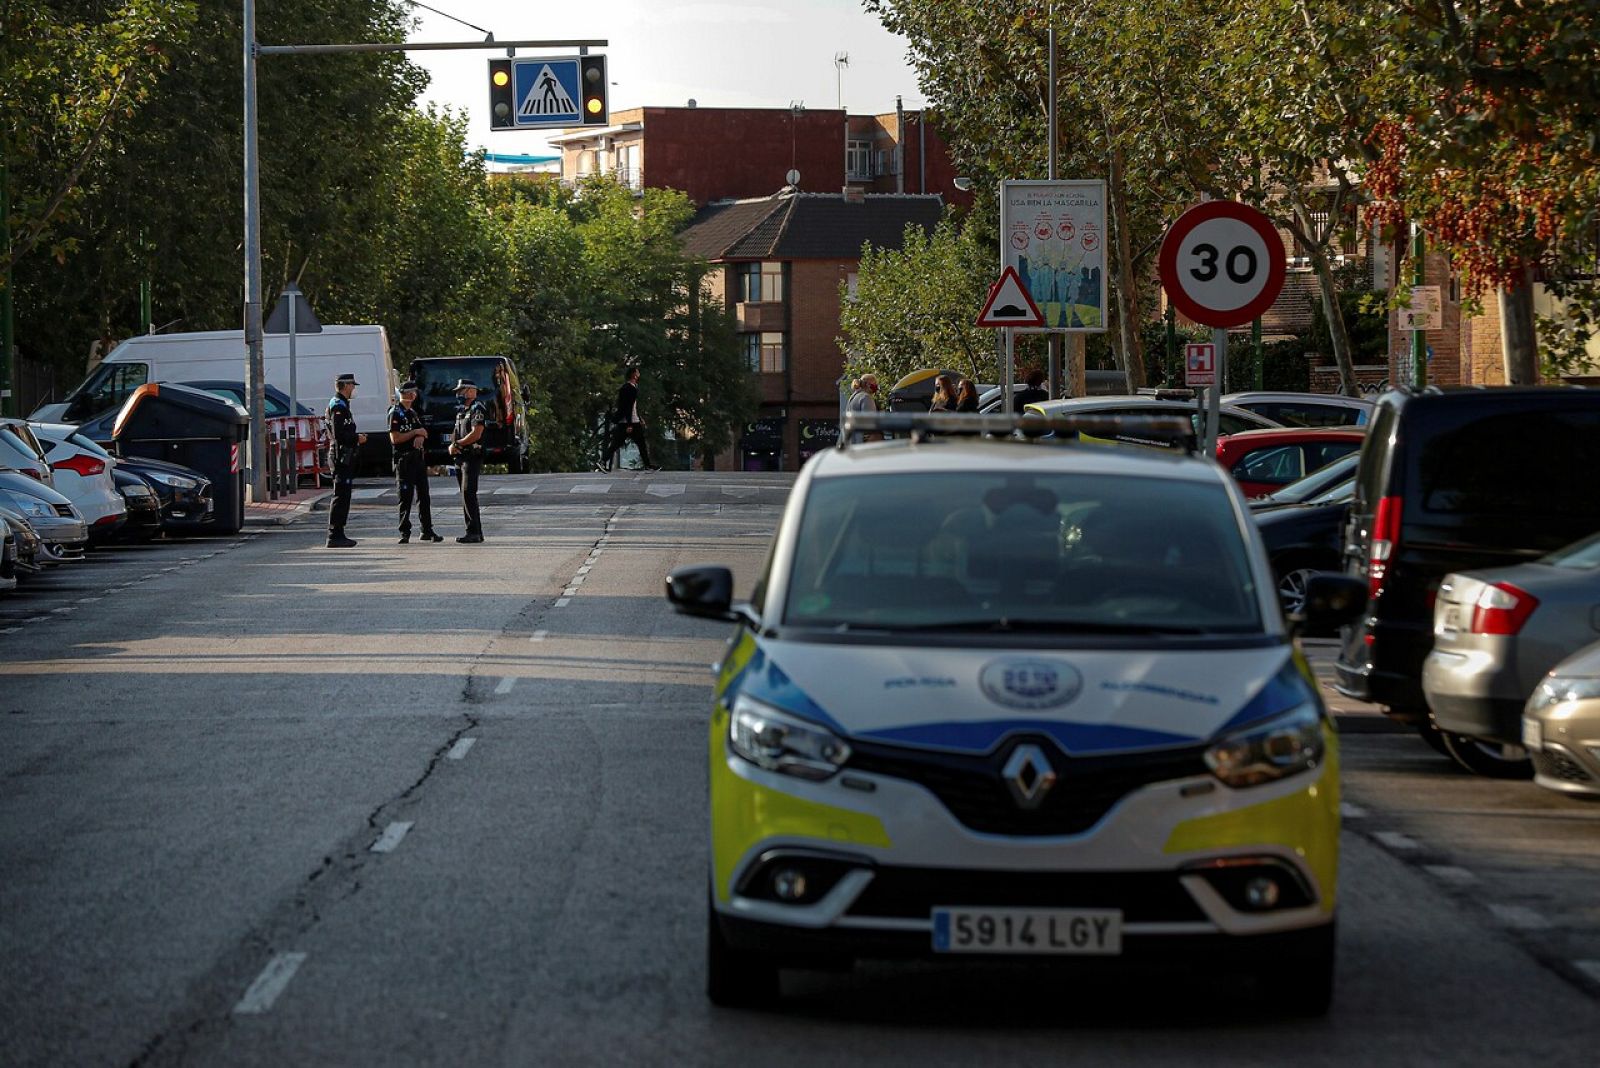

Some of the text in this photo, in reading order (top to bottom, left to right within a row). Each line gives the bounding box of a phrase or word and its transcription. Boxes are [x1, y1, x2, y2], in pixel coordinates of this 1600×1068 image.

[1010, 199, 1026, 207] USA
[1043, 199, 1052, 207] LA
[1054, 199, 1099, 207] MASCARILLA
[1190, 243, 1258, 284] 30
[1190, 347, 1211, 370] H
[955, 913, 1111, 949] 5914 LGY
